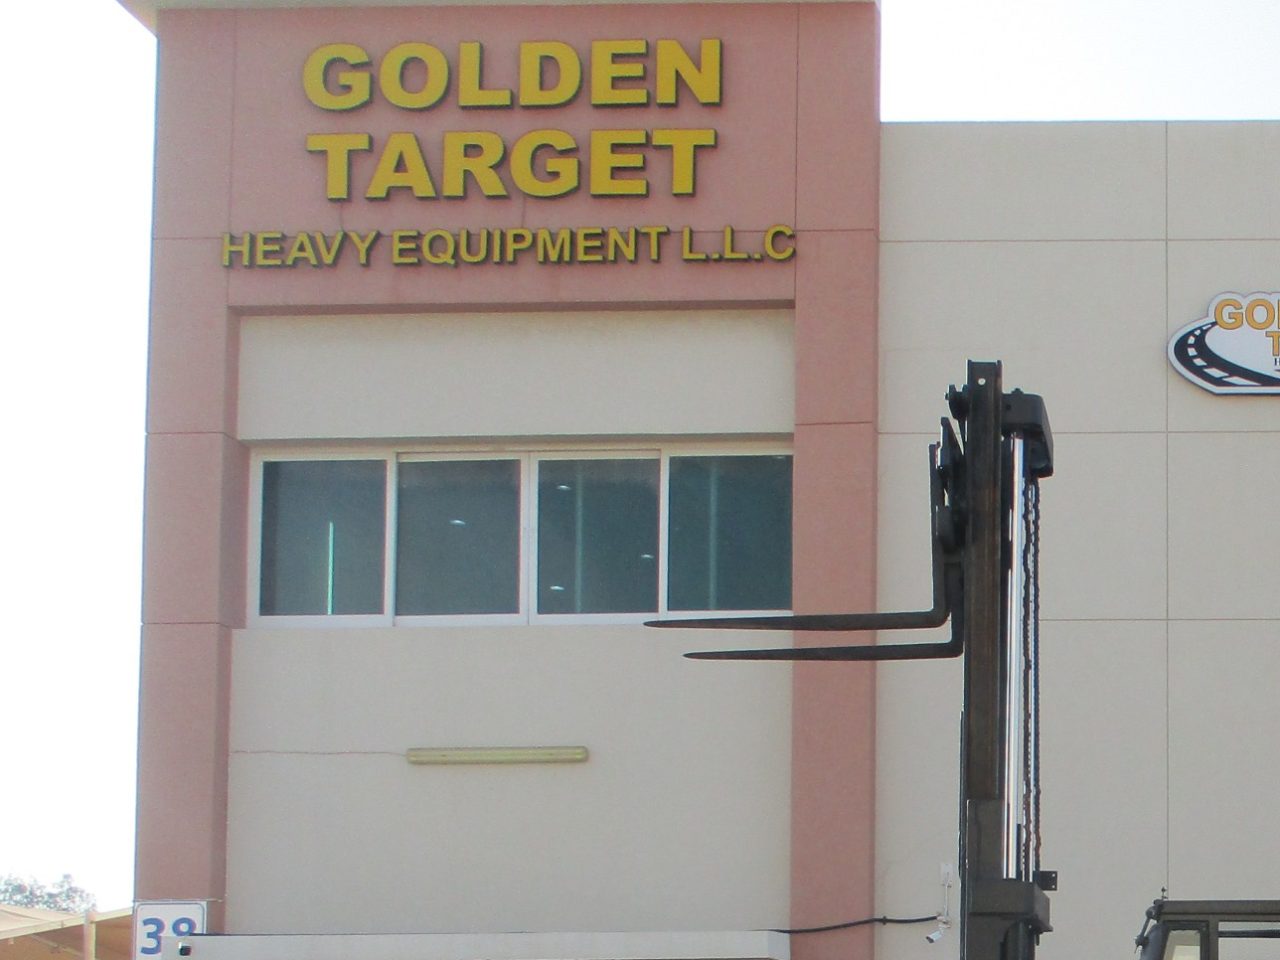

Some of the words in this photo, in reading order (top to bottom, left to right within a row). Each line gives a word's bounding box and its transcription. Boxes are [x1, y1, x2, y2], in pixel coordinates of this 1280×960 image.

[303, 38, 723, 111] GOLDEN
[306, 128, 716, 201] TARGET
[221, 228, 378, 268] HEAVY
[391, 225, 669, 266] EQUIPMENT
[681, 224, 797, 262] L.L.C
